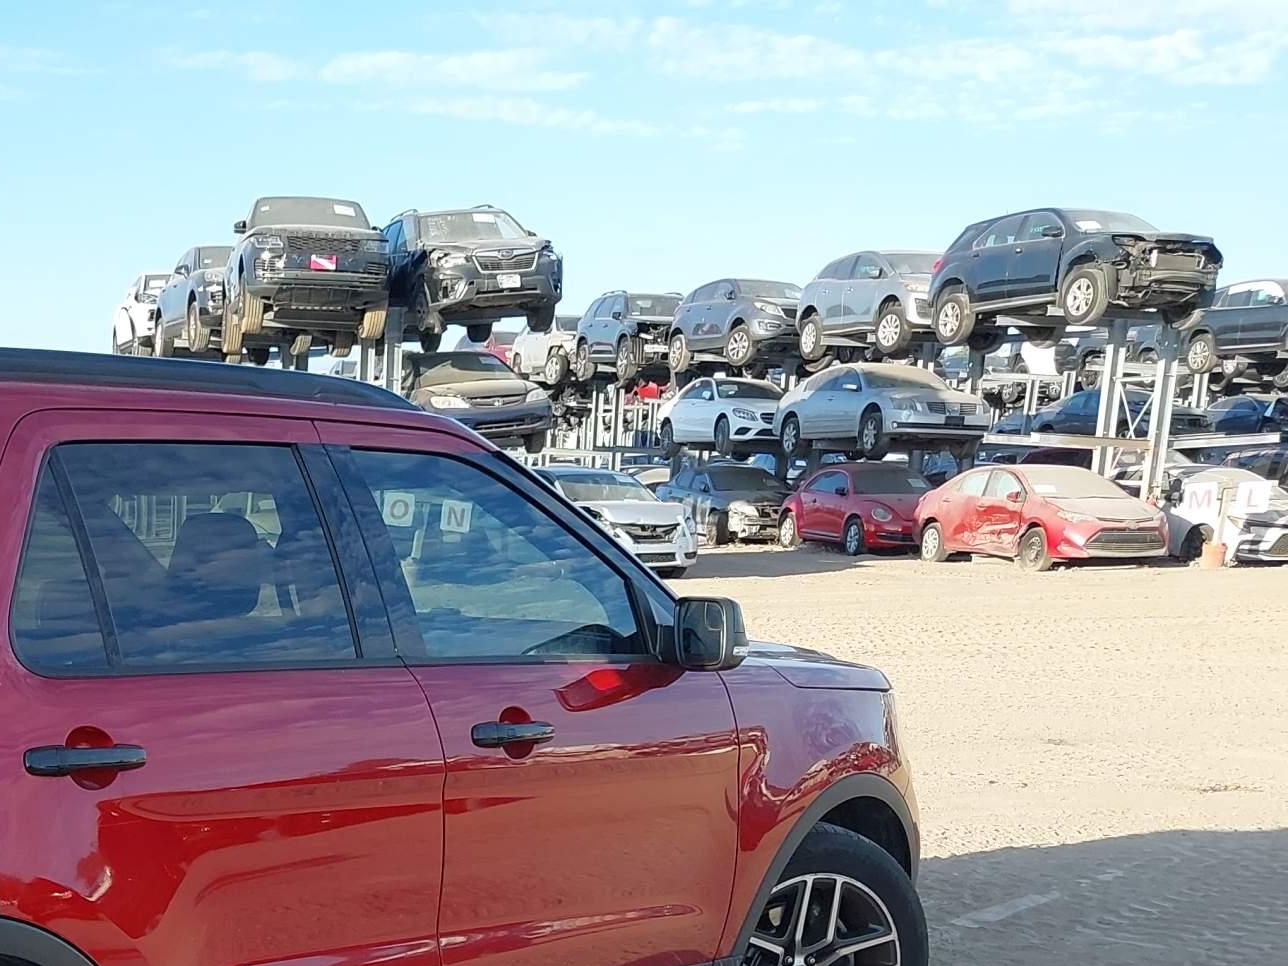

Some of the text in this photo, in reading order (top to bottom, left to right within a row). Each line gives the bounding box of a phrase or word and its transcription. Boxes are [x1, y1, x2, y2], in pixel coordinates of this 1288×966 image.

[1189, 488, 1212, 509] M
[1246, 488, 1258, 507] L
[389, 499, 410, 519] O
[447, 506, 465, 527] N
